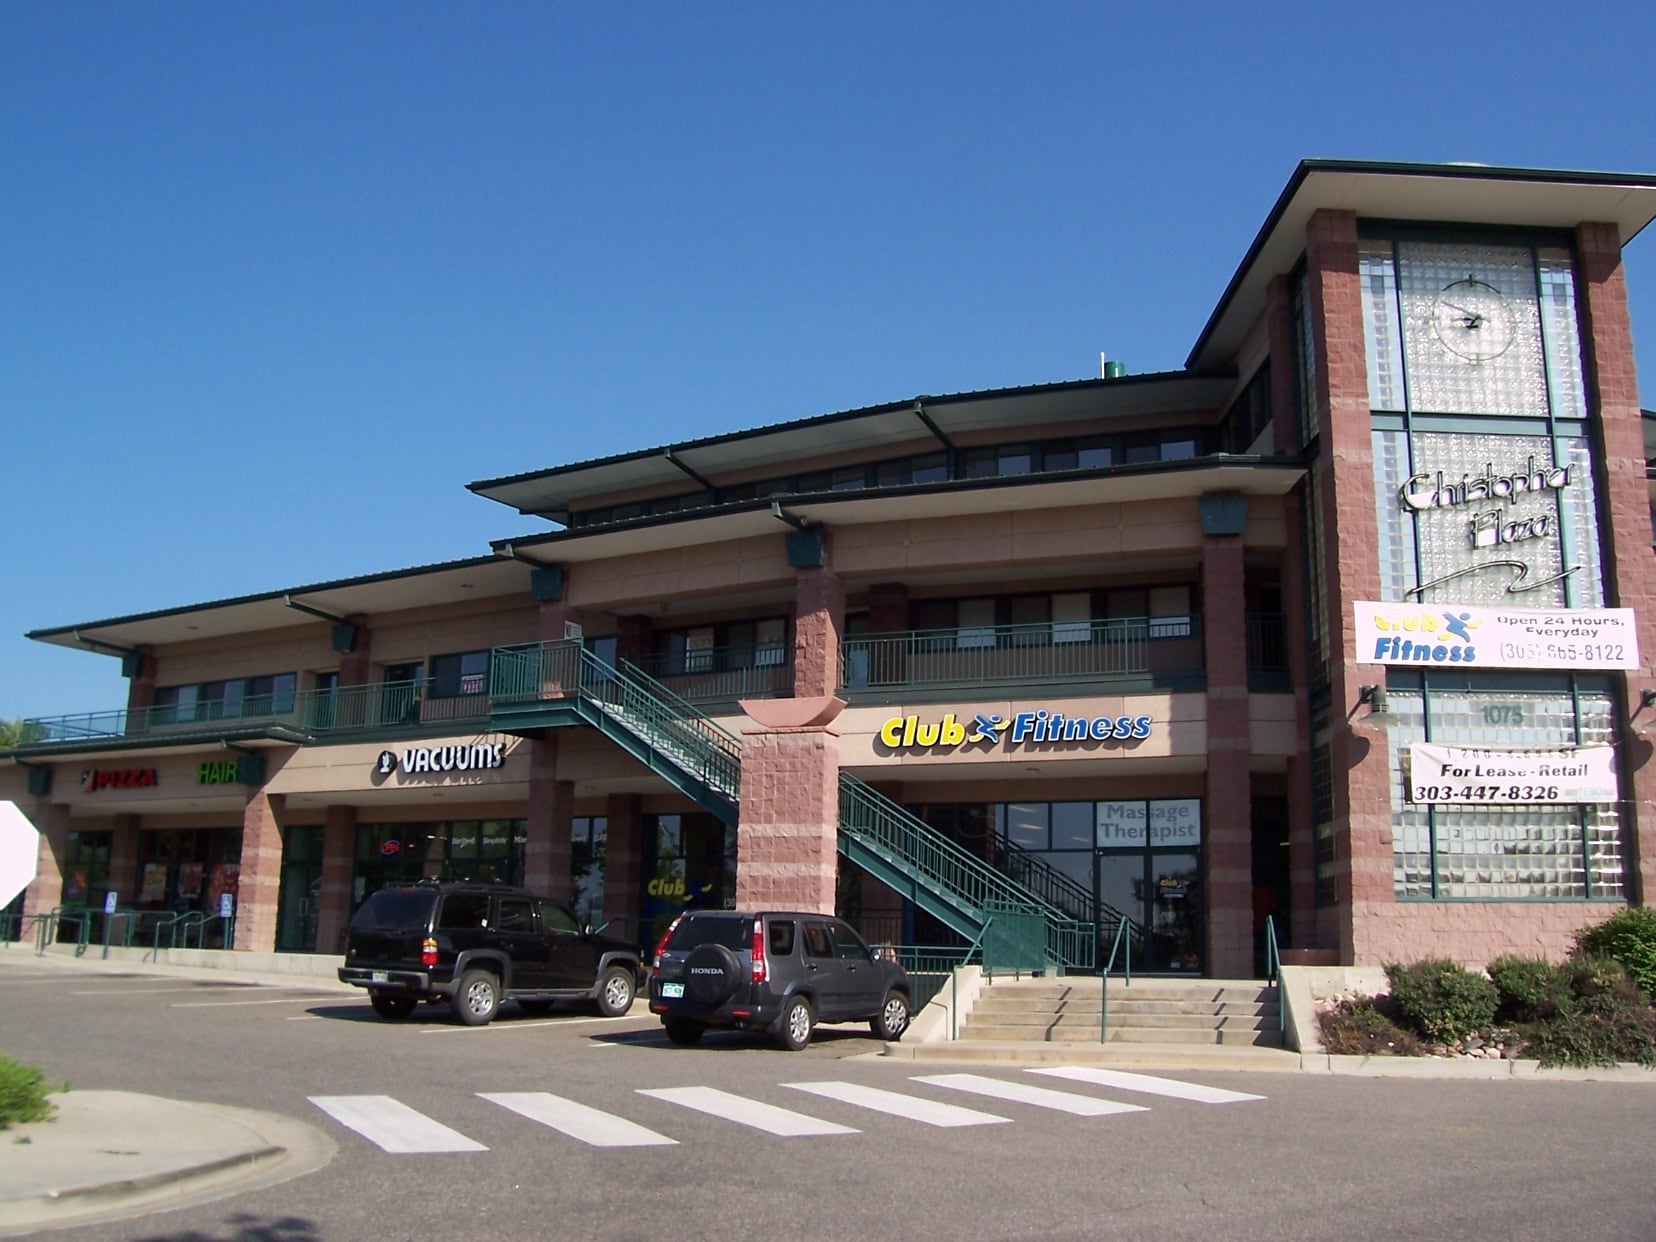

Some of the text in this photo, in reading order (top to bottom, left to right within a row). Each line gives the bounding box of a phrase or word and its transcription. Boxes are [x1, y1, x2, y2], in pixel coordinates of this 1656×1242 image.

[1402, 455, 1575, 509] Christopher
[1471, 508, 1551, 549] Plaza
[1497, 616, 1625, 627] Open 24 Hours,
[1526, 627, 1598, 638] Everyday
[1374, 636, 1476, 662] Fitness
[1480, 704, 1524, 724] 1075
[880, 709, 1153, 748] Club Fitness
[403, 742, 504, 773] VACUUMS
[97, 768, 154, 789] PIZZA
[197, 761, 238, 785] HAIR
[1440, 763, 1471, 777] For
[1475, 764, 1526, 777] Lease
[1539, 763, 1588, 777] Retail
[1414, 785, 1559, 800] 303-447-8326
[1107, 804, 1189, 822] Massage
[1101, 823, 1196, 842] Therapist
[648, 879, 686, 896] Club
[691, 967, 725, 975] HONDA
